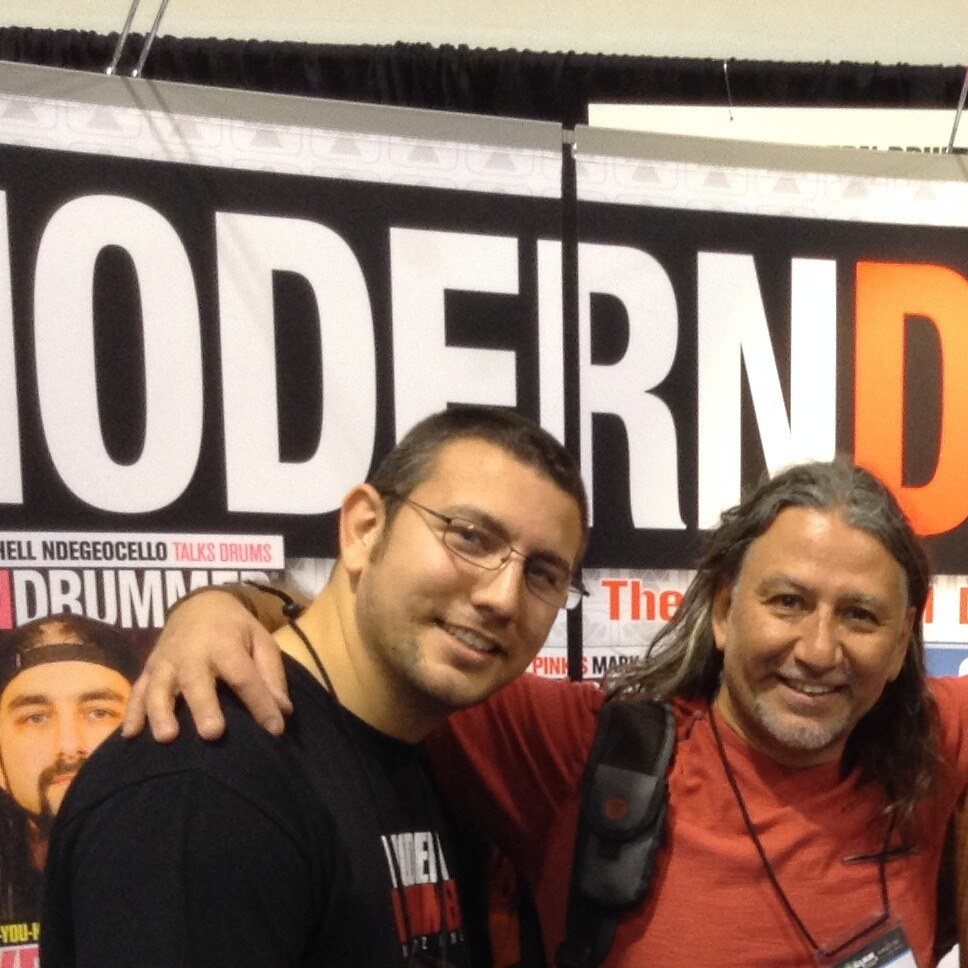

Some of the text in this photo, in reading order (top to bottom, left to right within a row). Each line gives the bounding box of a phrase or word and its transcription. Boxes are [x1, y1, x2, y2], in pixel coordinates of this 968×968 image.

[0, 189, 837, 530] ODERN
[41, 540, 168, 561] NDEGEOCELLO
[172, 542, 216, 562] TALKS
[219, 543, 272, 562] DRUMS
[13, 569, 271, 628] DRUMM
[602, 580, 685, 621] The
